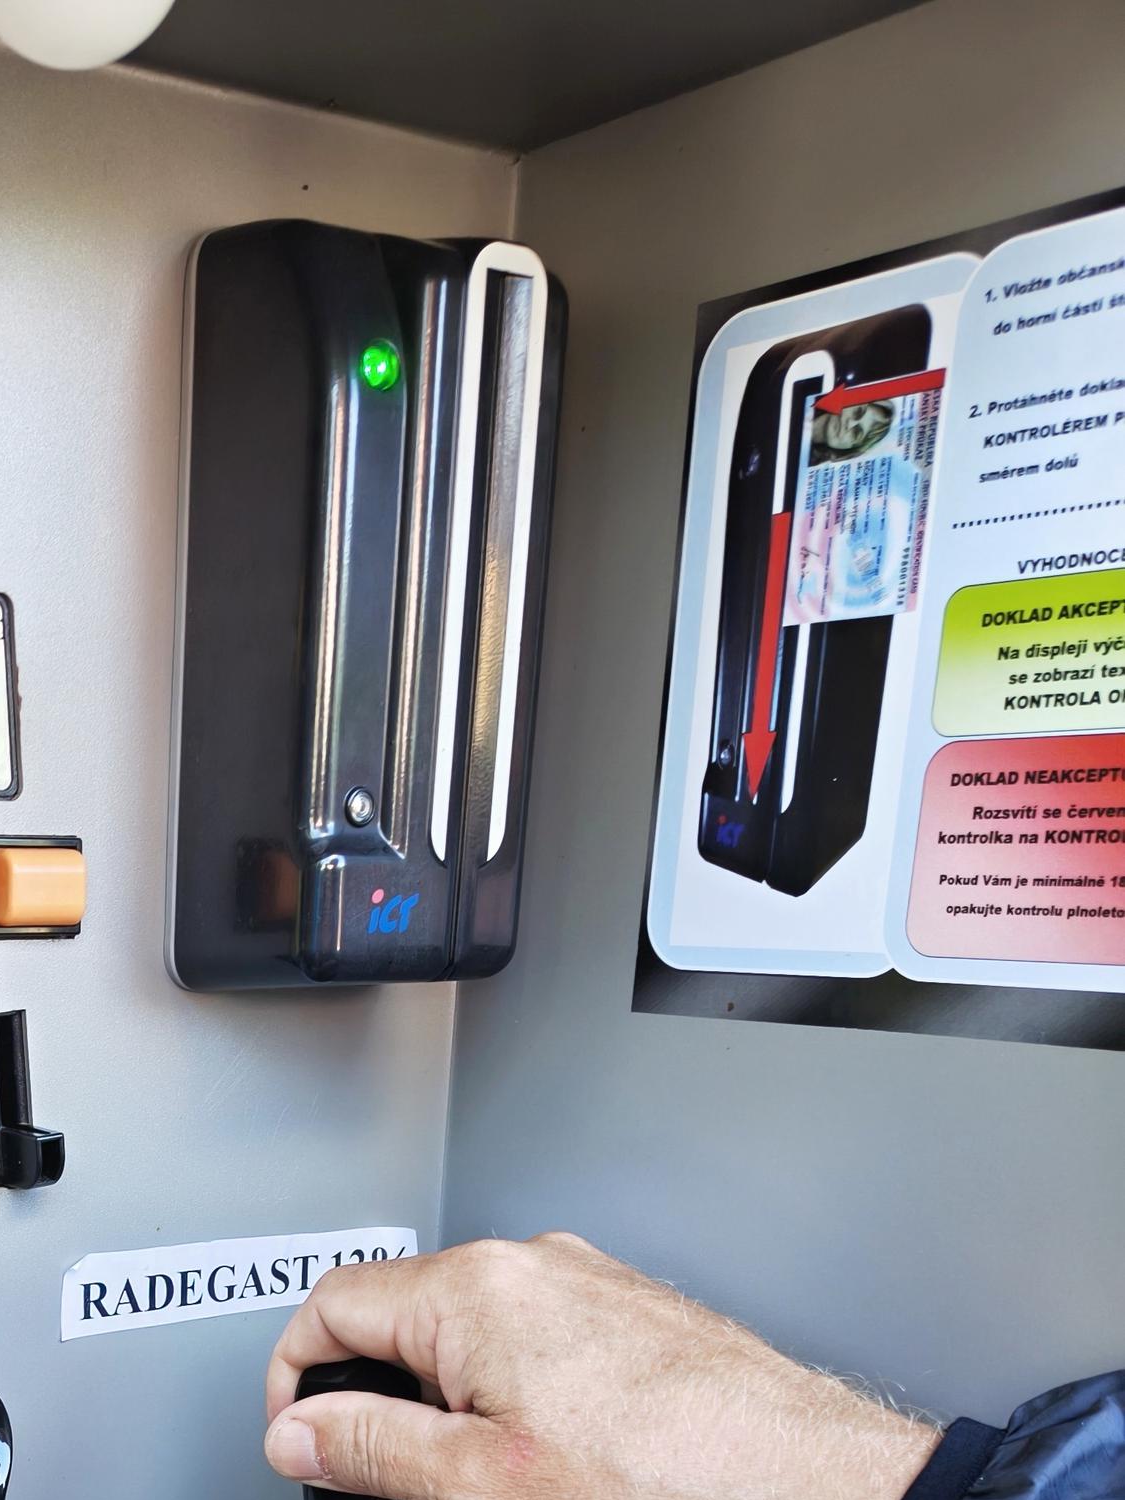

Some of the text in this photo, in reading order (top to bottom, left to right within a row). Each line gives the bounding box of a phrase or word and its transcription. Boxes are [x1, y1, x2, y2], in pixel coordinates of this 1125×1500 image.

[985, 288, 997, 303] 1.
[993, 321, 1012, 336] do
[981, 607, 1053, 627] DOKLAD
[997, 647, 1020, 661] Na
[1025, 639, 1088, 660] displeji
[1008, 673, 1028, 685] se
[1033, 664, 1096, 683] zobrazí
[1004, 691, 1101, 711] KONTROLA
[950, 771, 1019, 787] DOKLAD
[972, 805, 1038, 820] Rozsvítí
[1042, 807, 1061, 819] se
[938, 831, 1013, 844] kontrolka
[1019, 834, 1038, 844] na
[939, 874, 978, 886] Pokud
[983, 874, 1012, 886] Vám
[1015, 875, 1028, 889] je
[946, 904, 1002, 917] opakujte
[1006, 904, 1063, 917] kontrolu
[79, 1254, 319, 1321] RADEGAST
